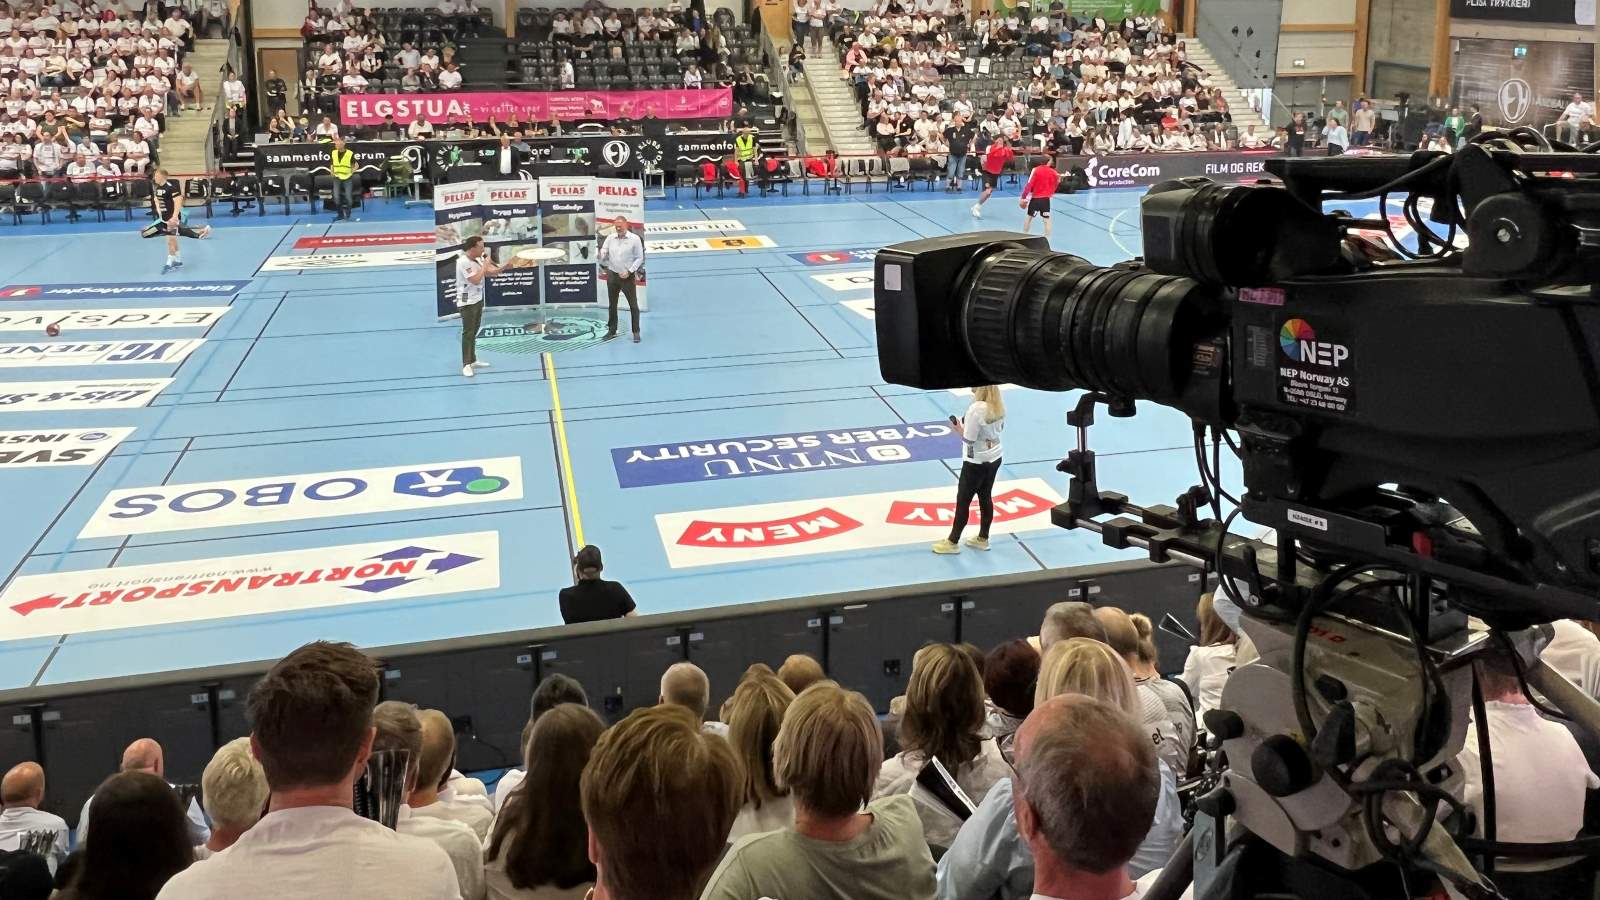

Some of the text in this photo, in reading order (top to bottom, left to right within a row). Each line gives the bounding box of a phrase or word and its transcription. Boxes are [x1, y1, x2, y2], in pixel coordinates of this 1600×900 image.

[346, 99, 463, 118] ELGSTUA
[1099, 164, 1160, 179] CoreCom
[1205, 163, 1228, 175] FILM
[1230, 162, 1243, 174] OG
[444, 191, 475, 203] PELIAS
[490, 190, 527, 199] PELIAS
[550, 186, 585, 195] PELIAS
[598, 185, 637, 197] PELIAS
[106, 342, 175, 362] YC
[1300, 339, 1349, 368] NEP
[1280, 367, 1298, 378] NEP
[1299, 369, 1336, 387] Norway
[1336, 376, 1350, 387] AS
[626, 425, 952, 463] CYBER SECURITY
[703, 448, 868, 477] NTNU
[108, 477, 368, 520] OBOS
[696, 515, 842, 543] MENY
[60, 559, 418, 610] NORTRANSPORT
[87, 565, 273, 589] www.nortransport.no
